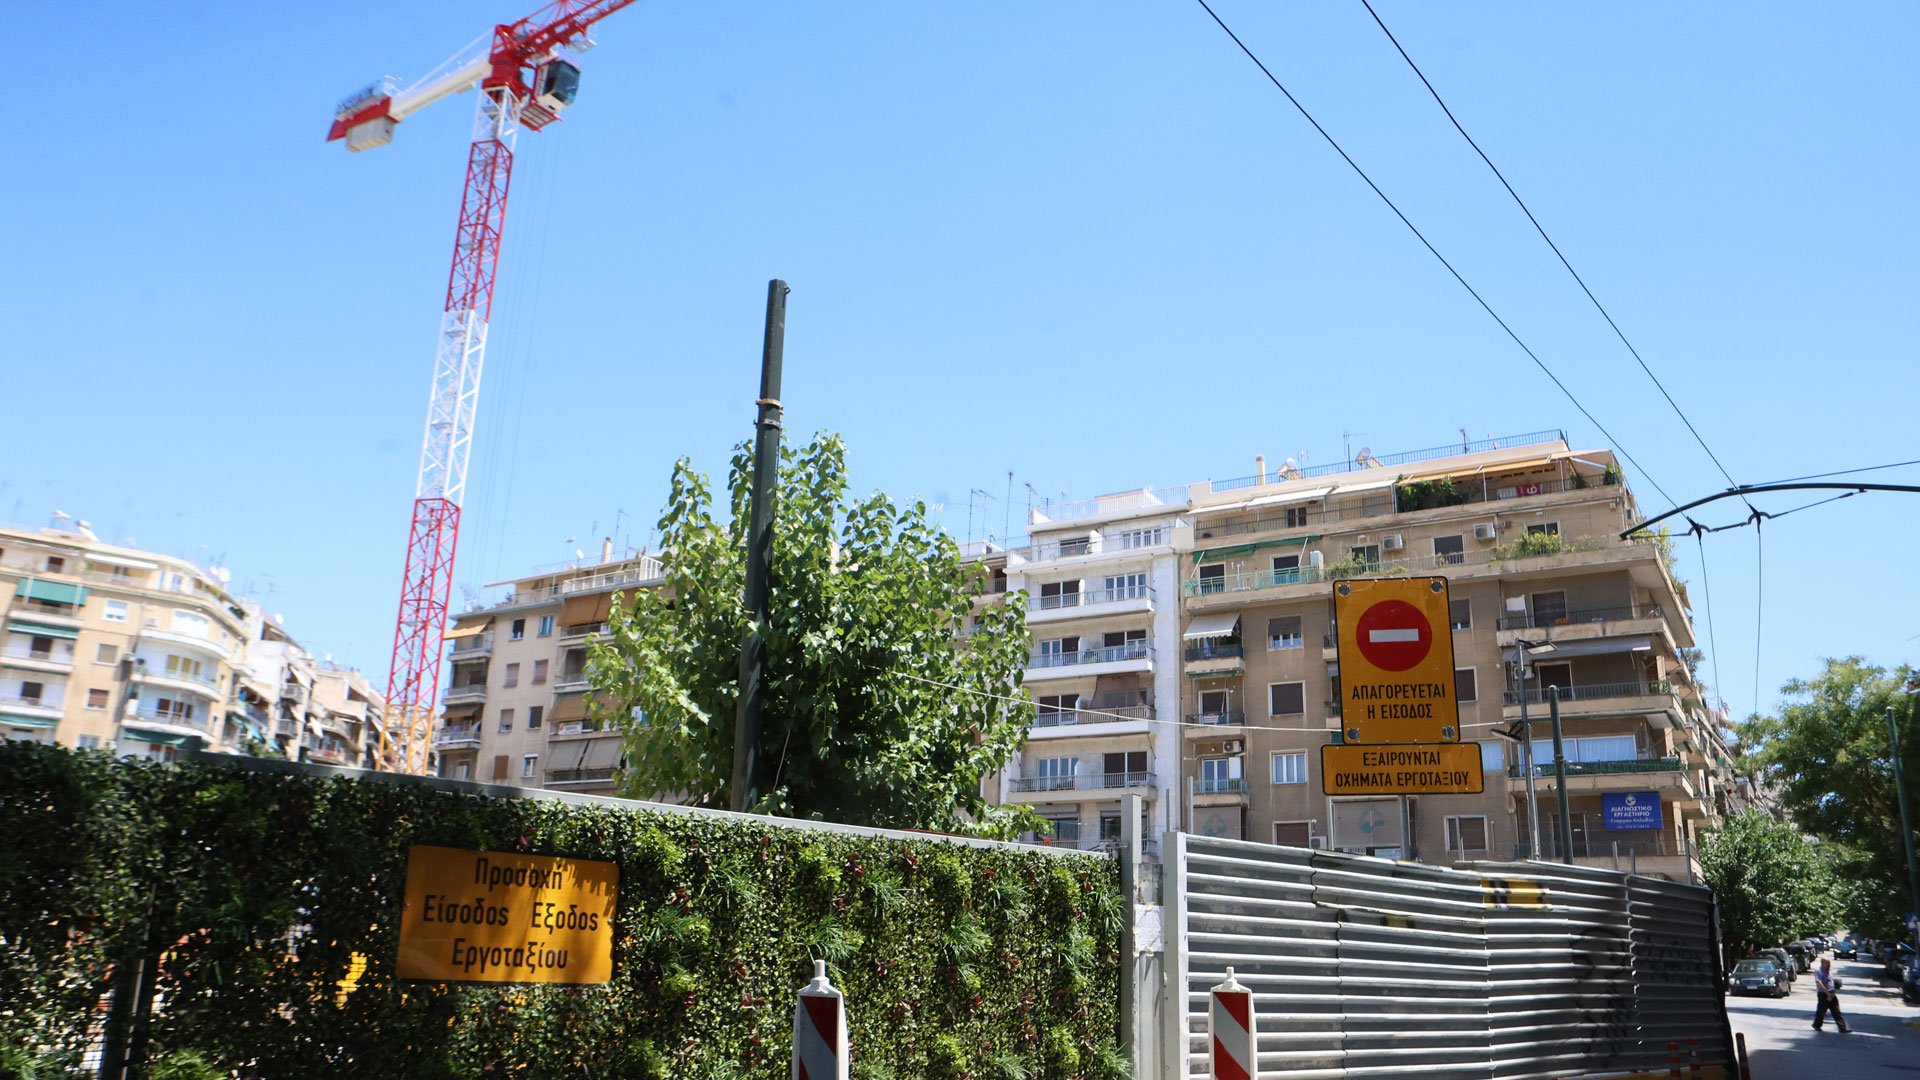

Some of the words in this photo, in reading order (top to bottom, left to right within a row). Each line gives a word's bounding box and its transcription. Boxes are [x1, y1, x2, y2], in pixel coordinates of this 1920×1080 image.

[1352, 683, 1445, 700] ΑΠΑΓΟΡΕΥΕΤΑΙ
[1367, 704, 1376, 719] Η
[1381, 703, 1433, 719] ΕΙΣΟΔΟΣ
[1363, 751, 1441, 767] ΕΞΑΙΡΟΥΝΤΑΙ
[1335, 772, 1392, 787] ΟΧΗΜΑΤΑ
[1397, 771, 1469, 786] ΕΡΓΟΤΑΞΙΟΥ
[474, 857, 563, 892] Προσοχή
[423, 894, 509, 927] Είσοδος
[531, 902, 598, 935] Εξοδος
[452, 938, 568, 974] Εργοταξίου
